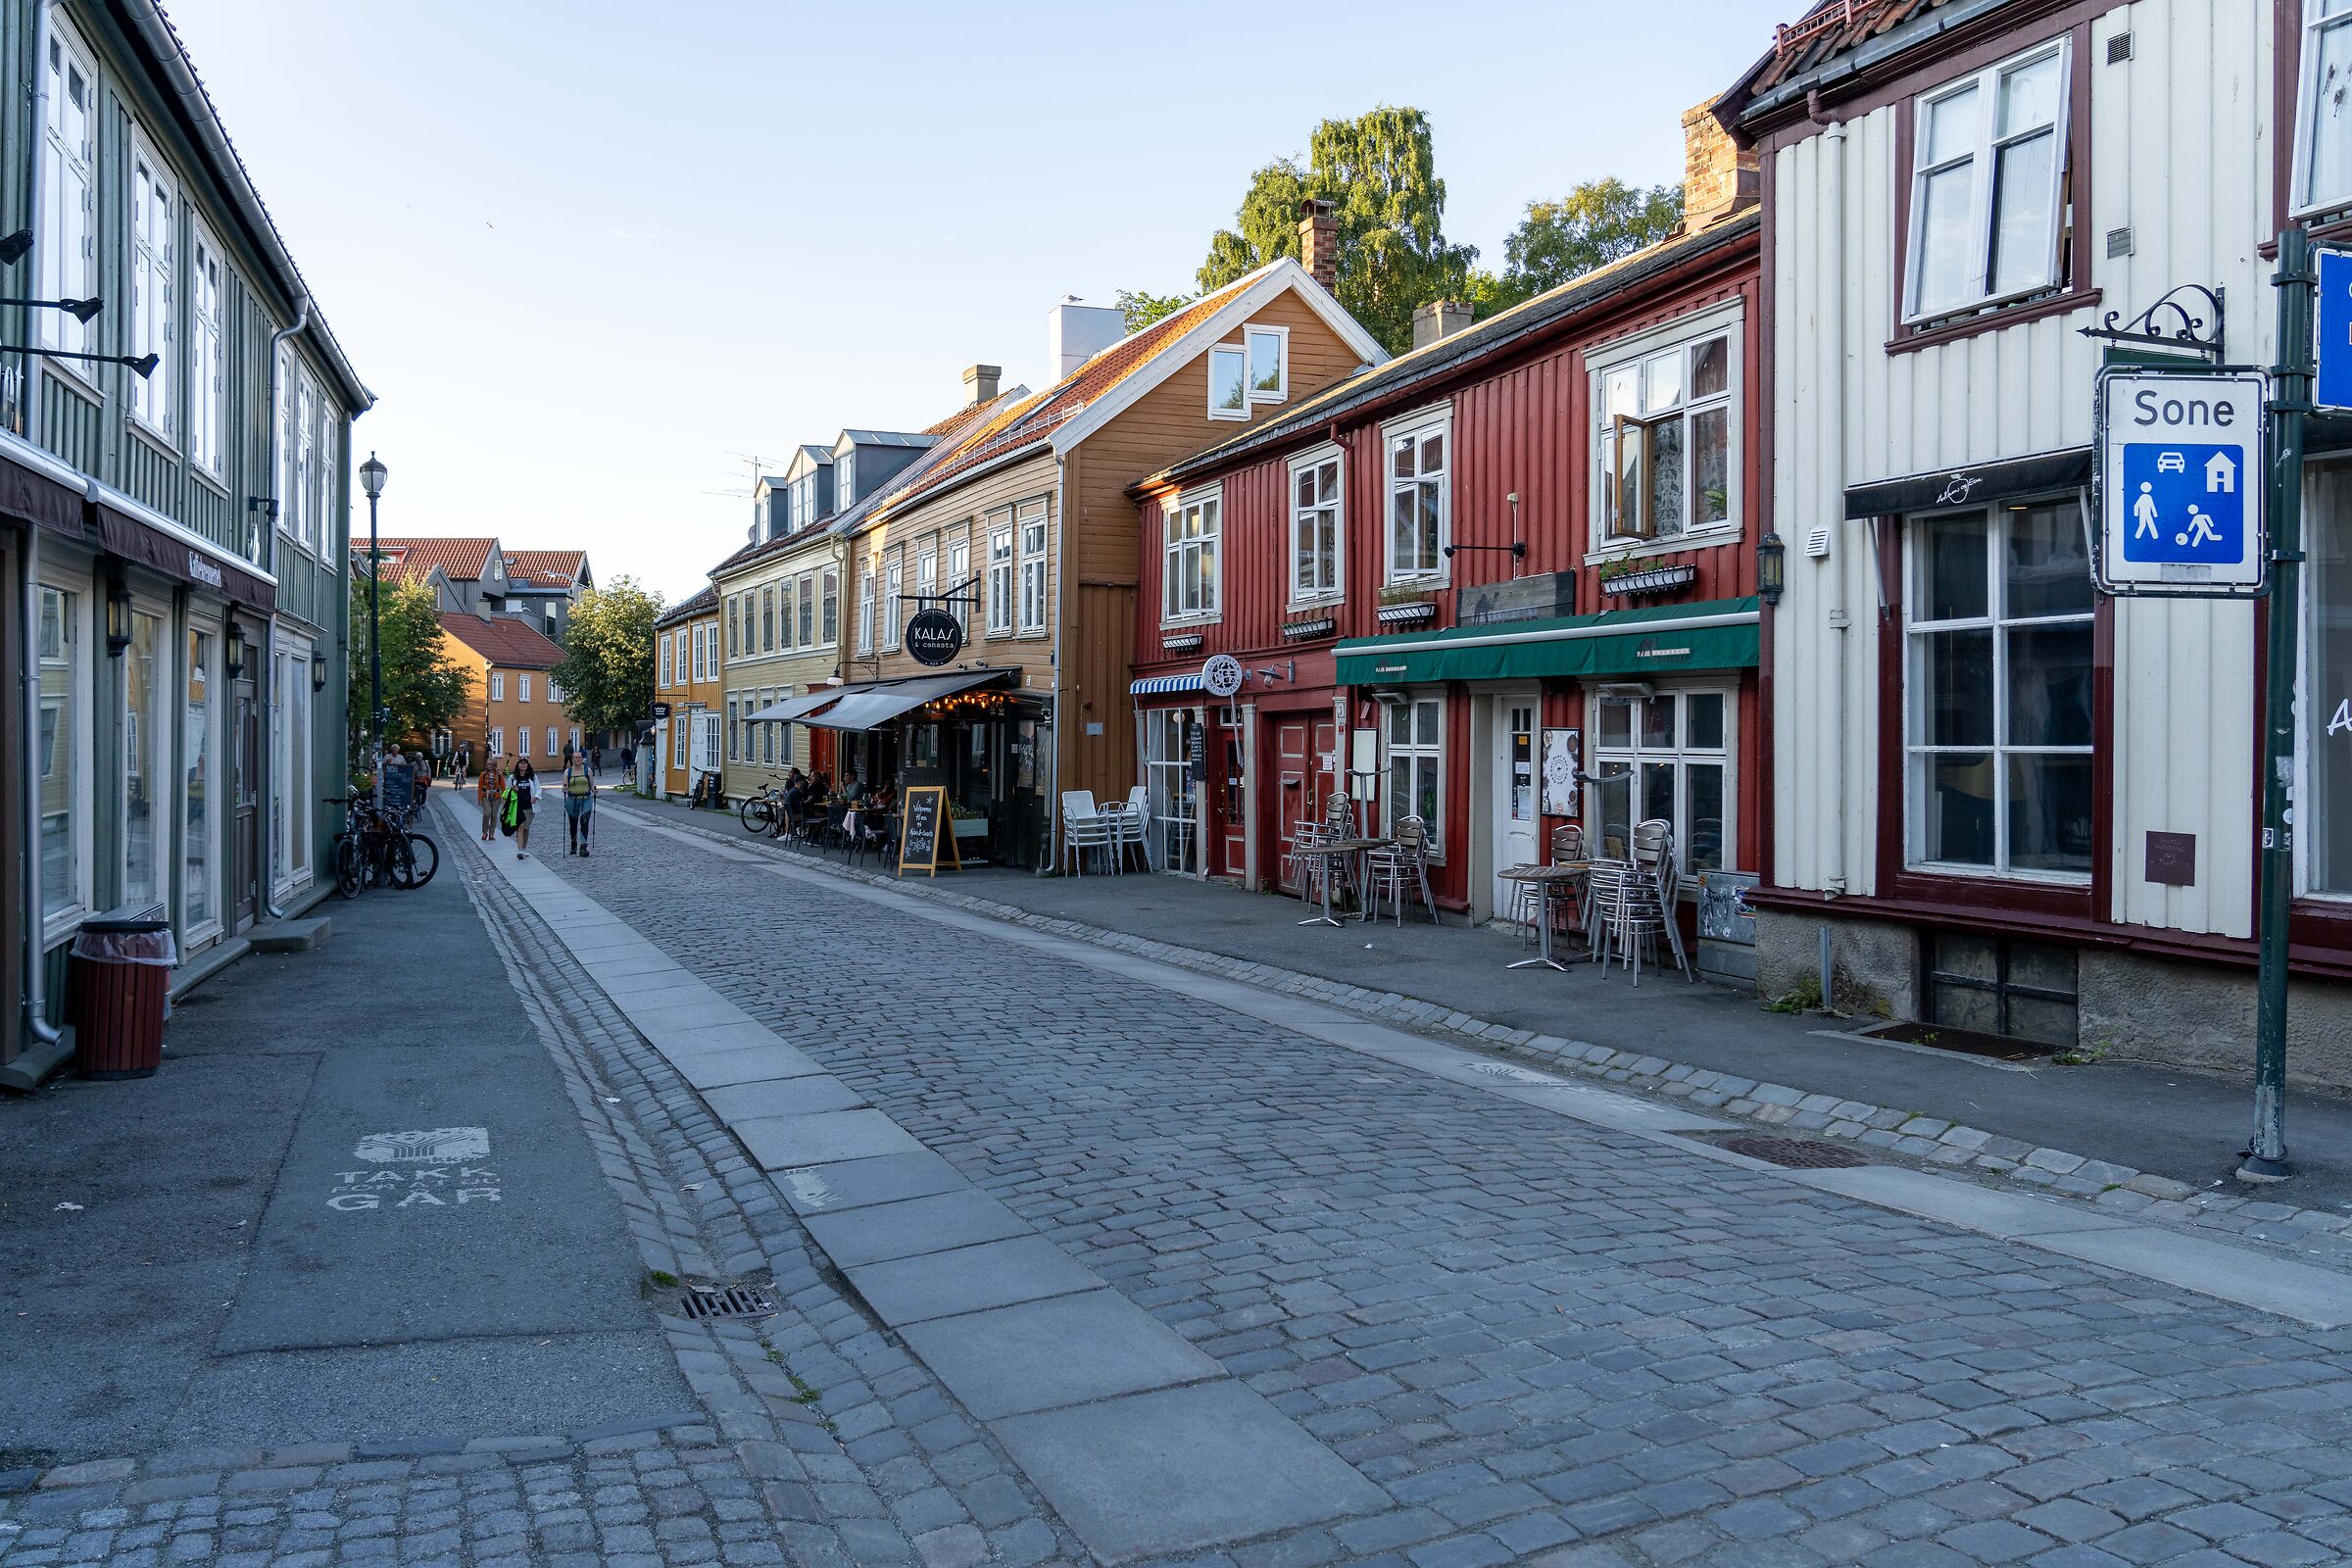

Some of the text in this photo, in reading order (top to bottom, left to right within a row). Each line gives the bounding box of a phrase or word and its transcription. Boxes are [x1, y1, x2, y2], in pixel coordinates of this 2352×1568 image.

[2134, 390, 2234, 426] Sone
[914, 627, 955, 640] KALAS
[1207, 658, 1220, 672] ALMA
[334, 1167, 498, 1184] TAKK
[330, 1183, 396, 1194] FOR
